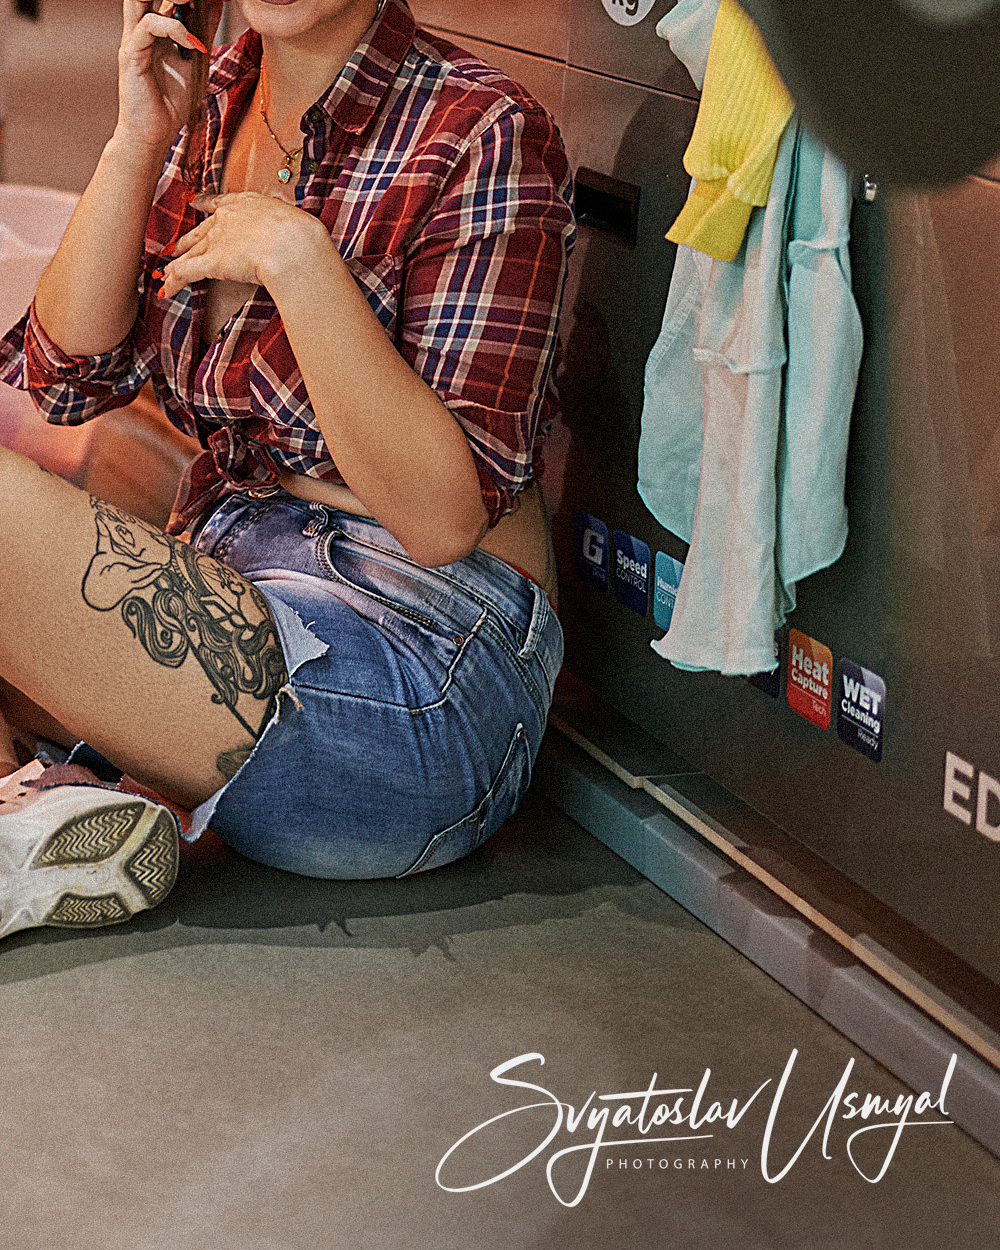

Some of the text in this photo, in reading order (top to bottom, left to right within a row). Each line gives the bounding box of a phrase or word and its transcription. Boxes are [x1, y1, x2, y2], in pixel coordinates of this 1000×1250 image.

[583, 528, 605, 565] G
[616, 549, 648, 579] Speed
[616, 567, 647, 593] CONTROL
[792, 645, 829, 686] Heat
[791, 669, 828, 700] Capture
[842, 674, 882, 715] WET
[812, 700, 827, 716] Tech
[841, 698, 881, 734] Cleaning
[857, 728, 879, 750] Ready
